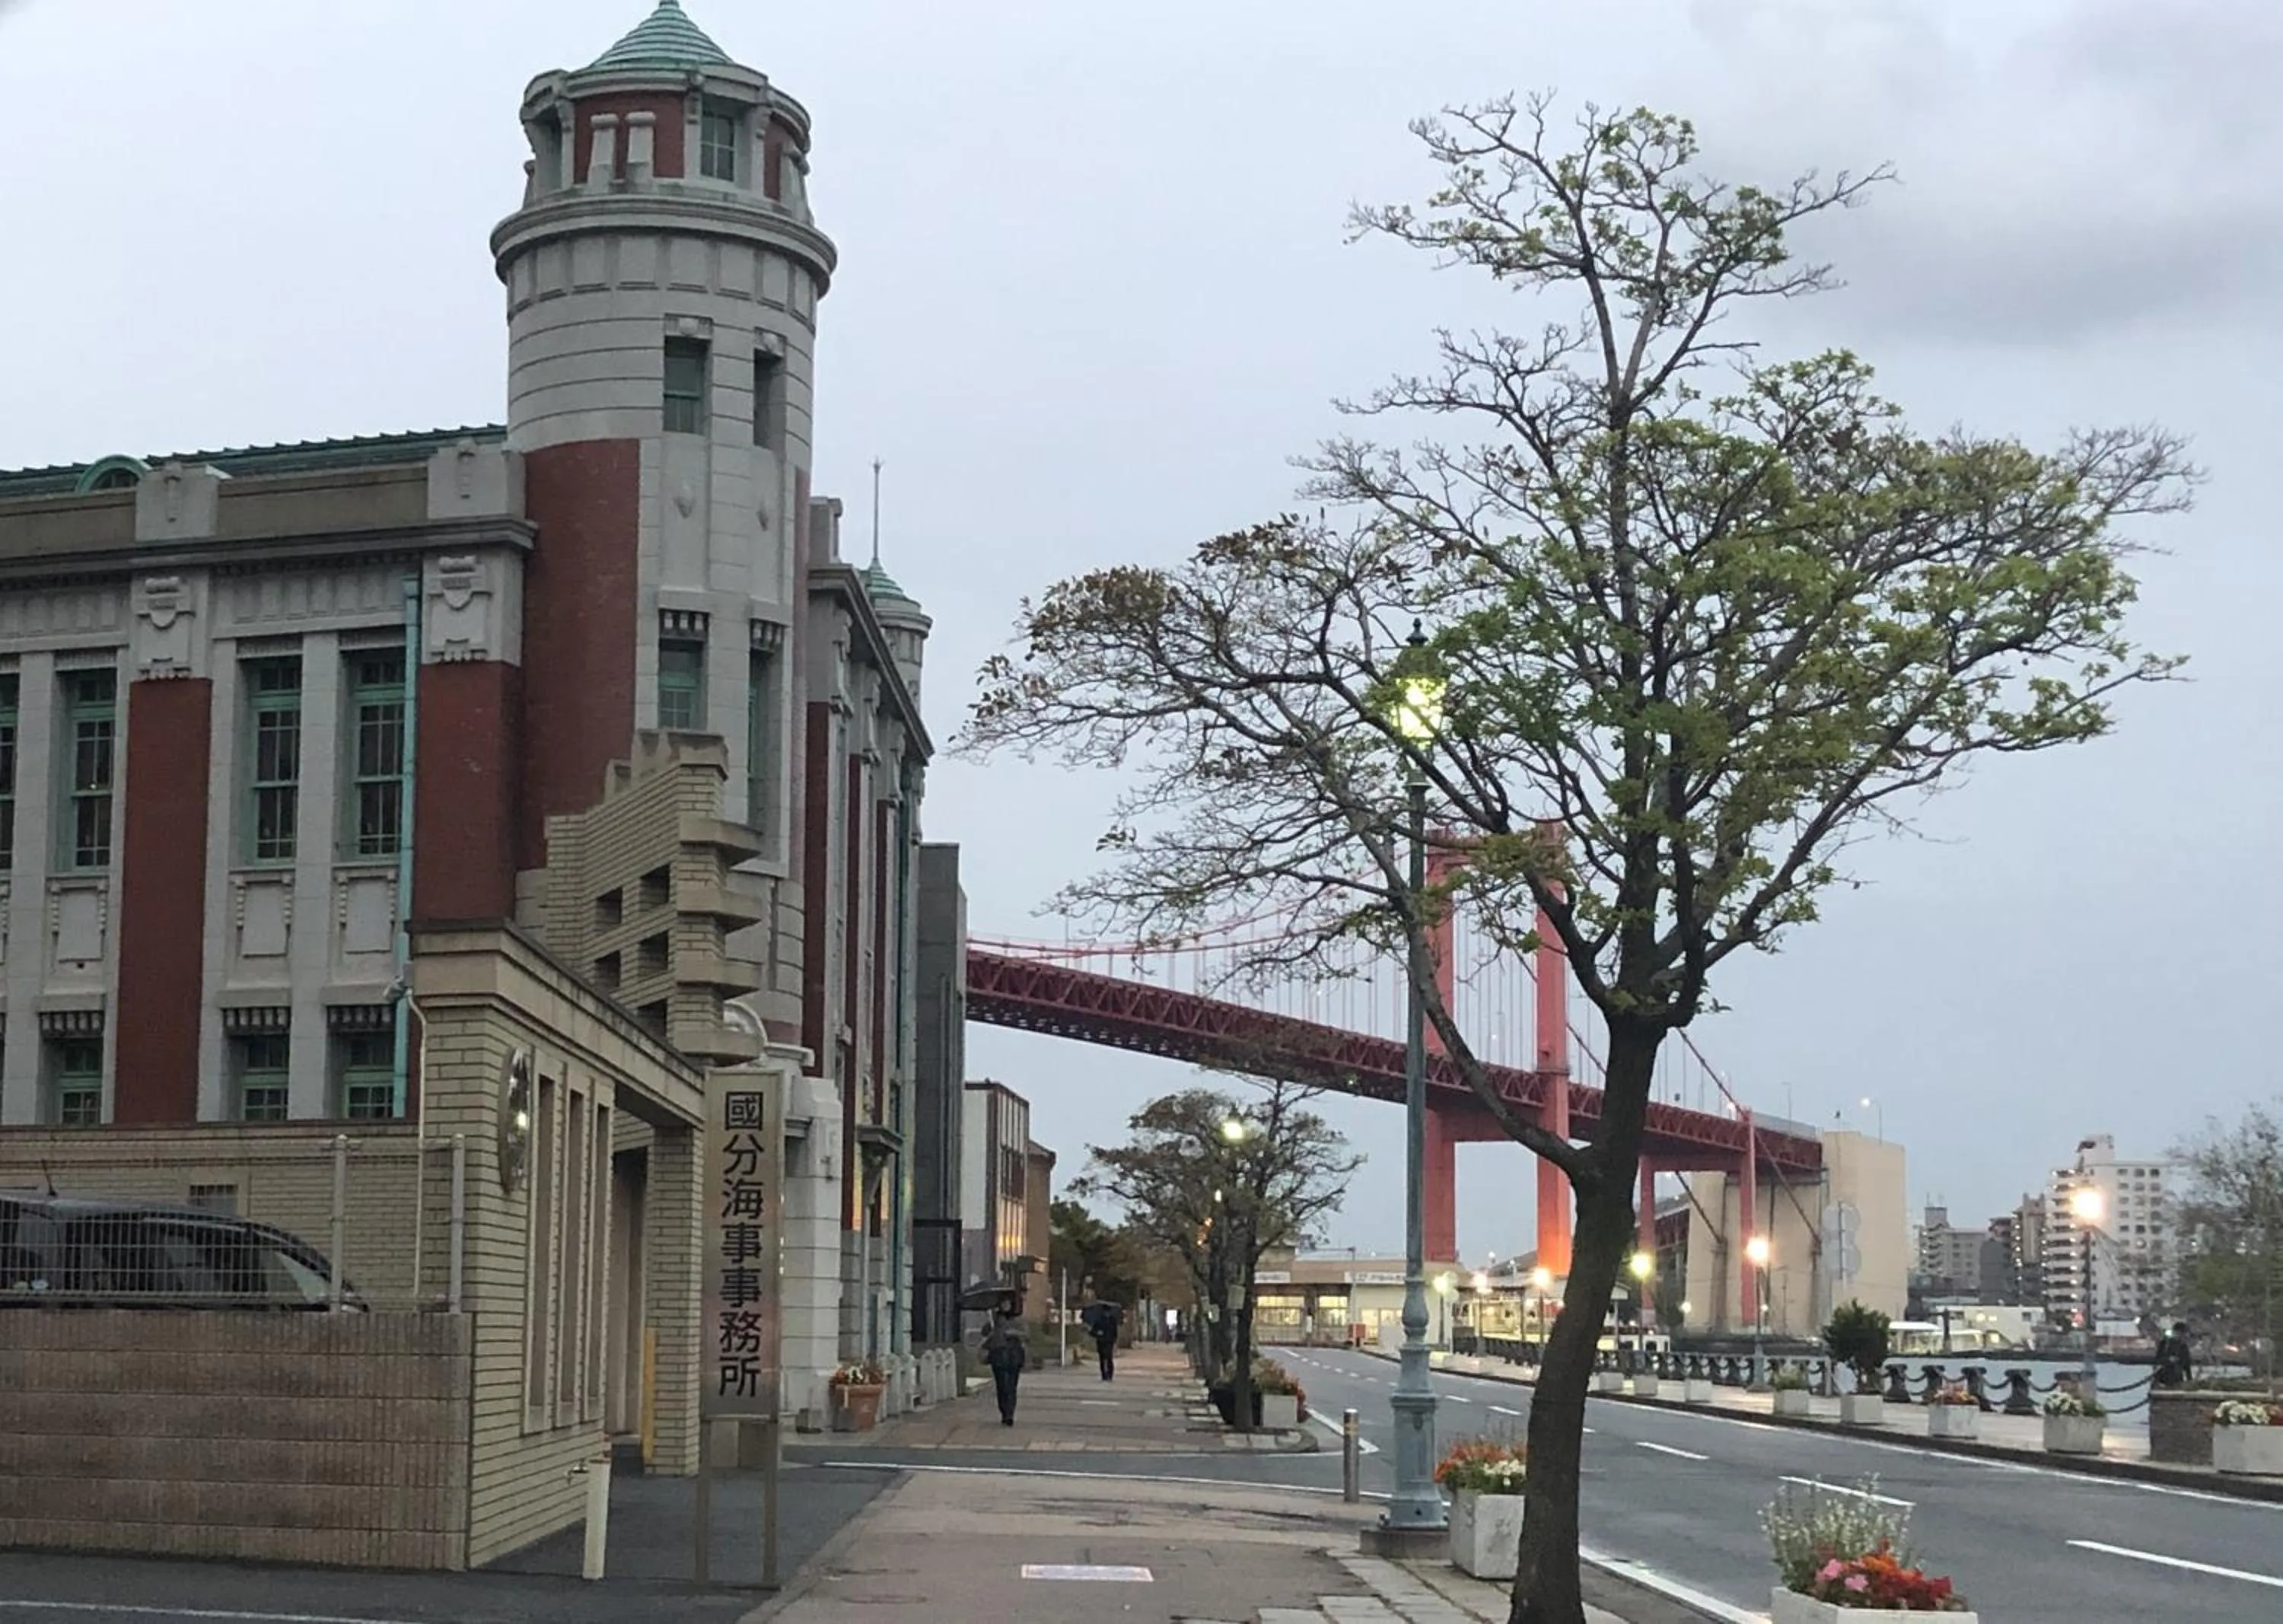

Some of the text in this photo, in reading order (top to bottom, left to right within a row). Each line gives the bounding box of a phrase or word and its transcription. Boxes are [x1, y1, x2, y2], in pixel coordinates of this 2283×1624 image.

[719, 1091, 764, 1397] 國分海事事務所
